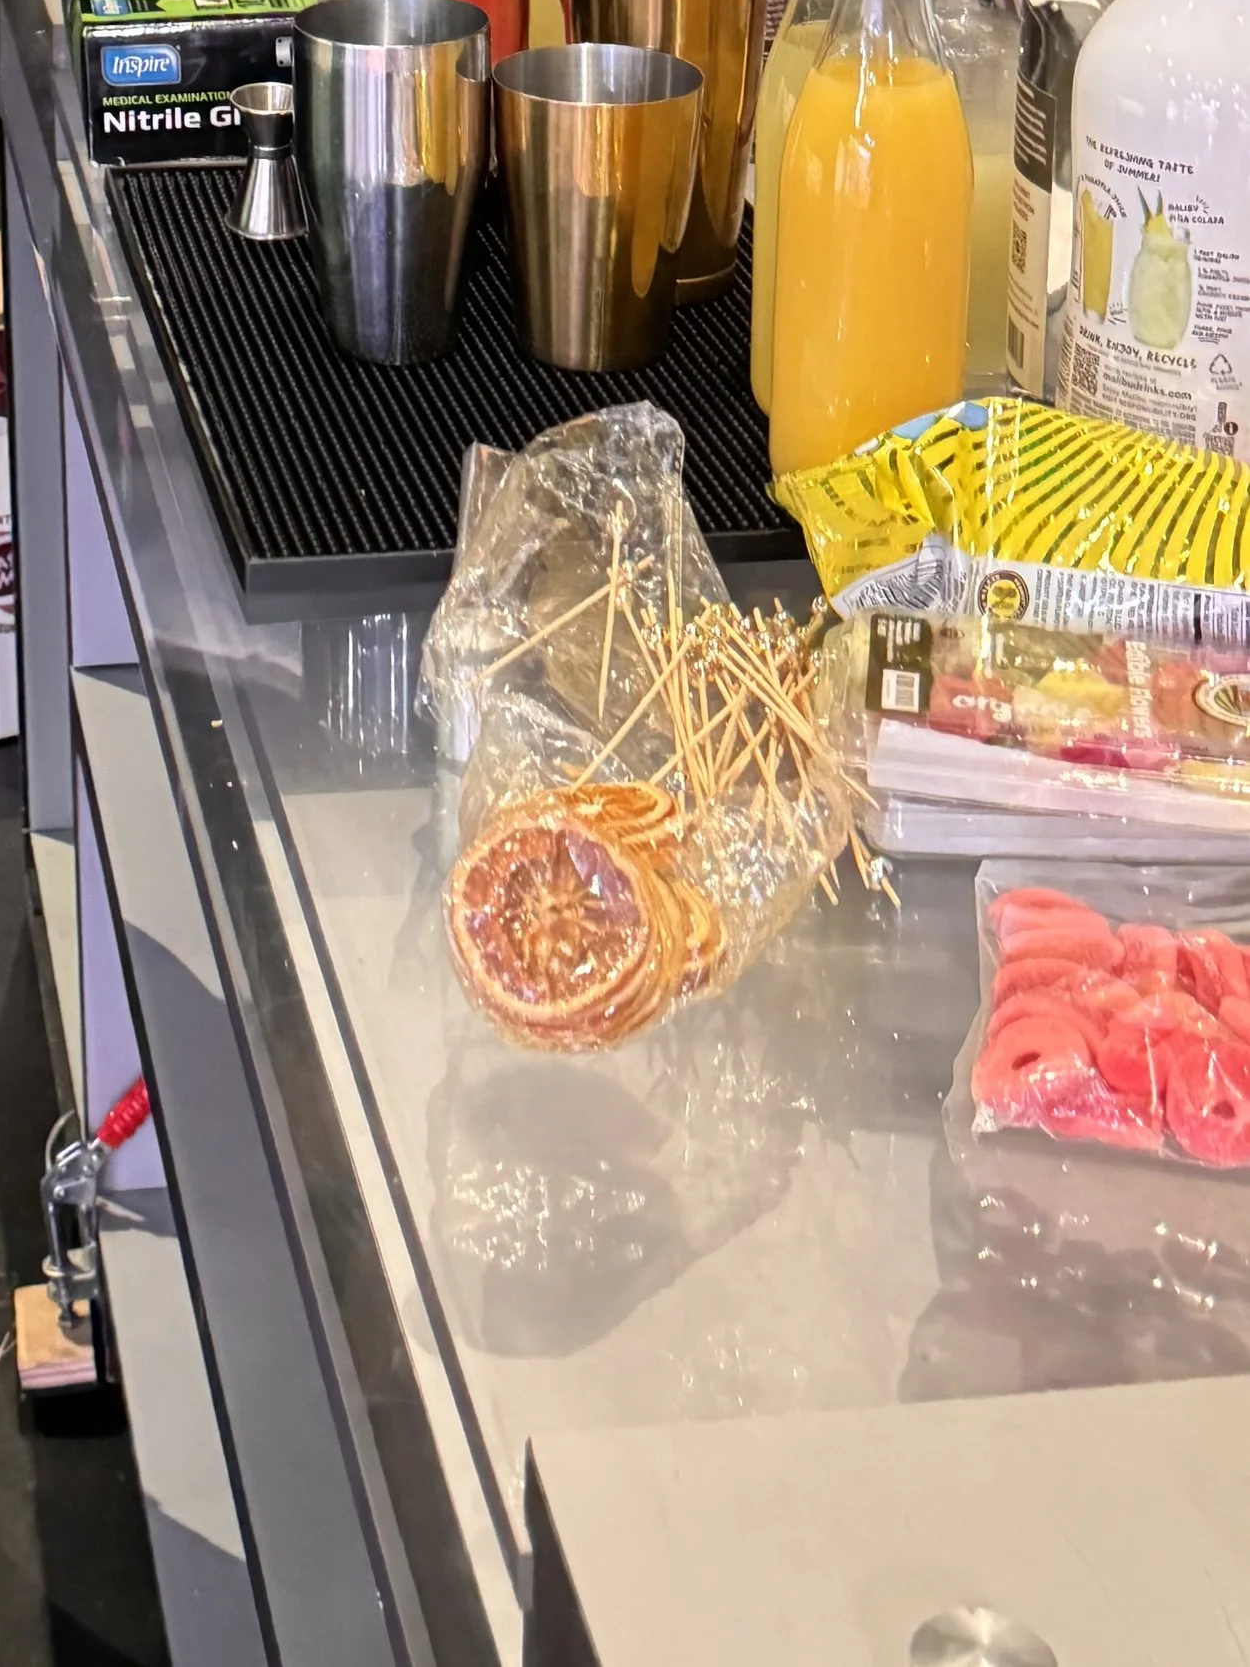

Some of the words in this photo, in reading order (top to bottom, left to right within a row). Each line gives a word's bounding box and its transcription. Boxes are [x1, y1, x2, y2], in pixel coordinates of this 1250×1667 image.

[112, 55, 171, 78] Inspire
[103, 93, 153, 107] MEDICAL
[103, 106, 201, 133] Nitrile
[209, 105, 241, 128] Gl
[1104, 159, 1114, 169] OF
[1158, 160, 1195, 175] TASTE
[1102, 372, 1192, 401] malibudrinks.com
[1126, 640, 1151, 684] Edible
